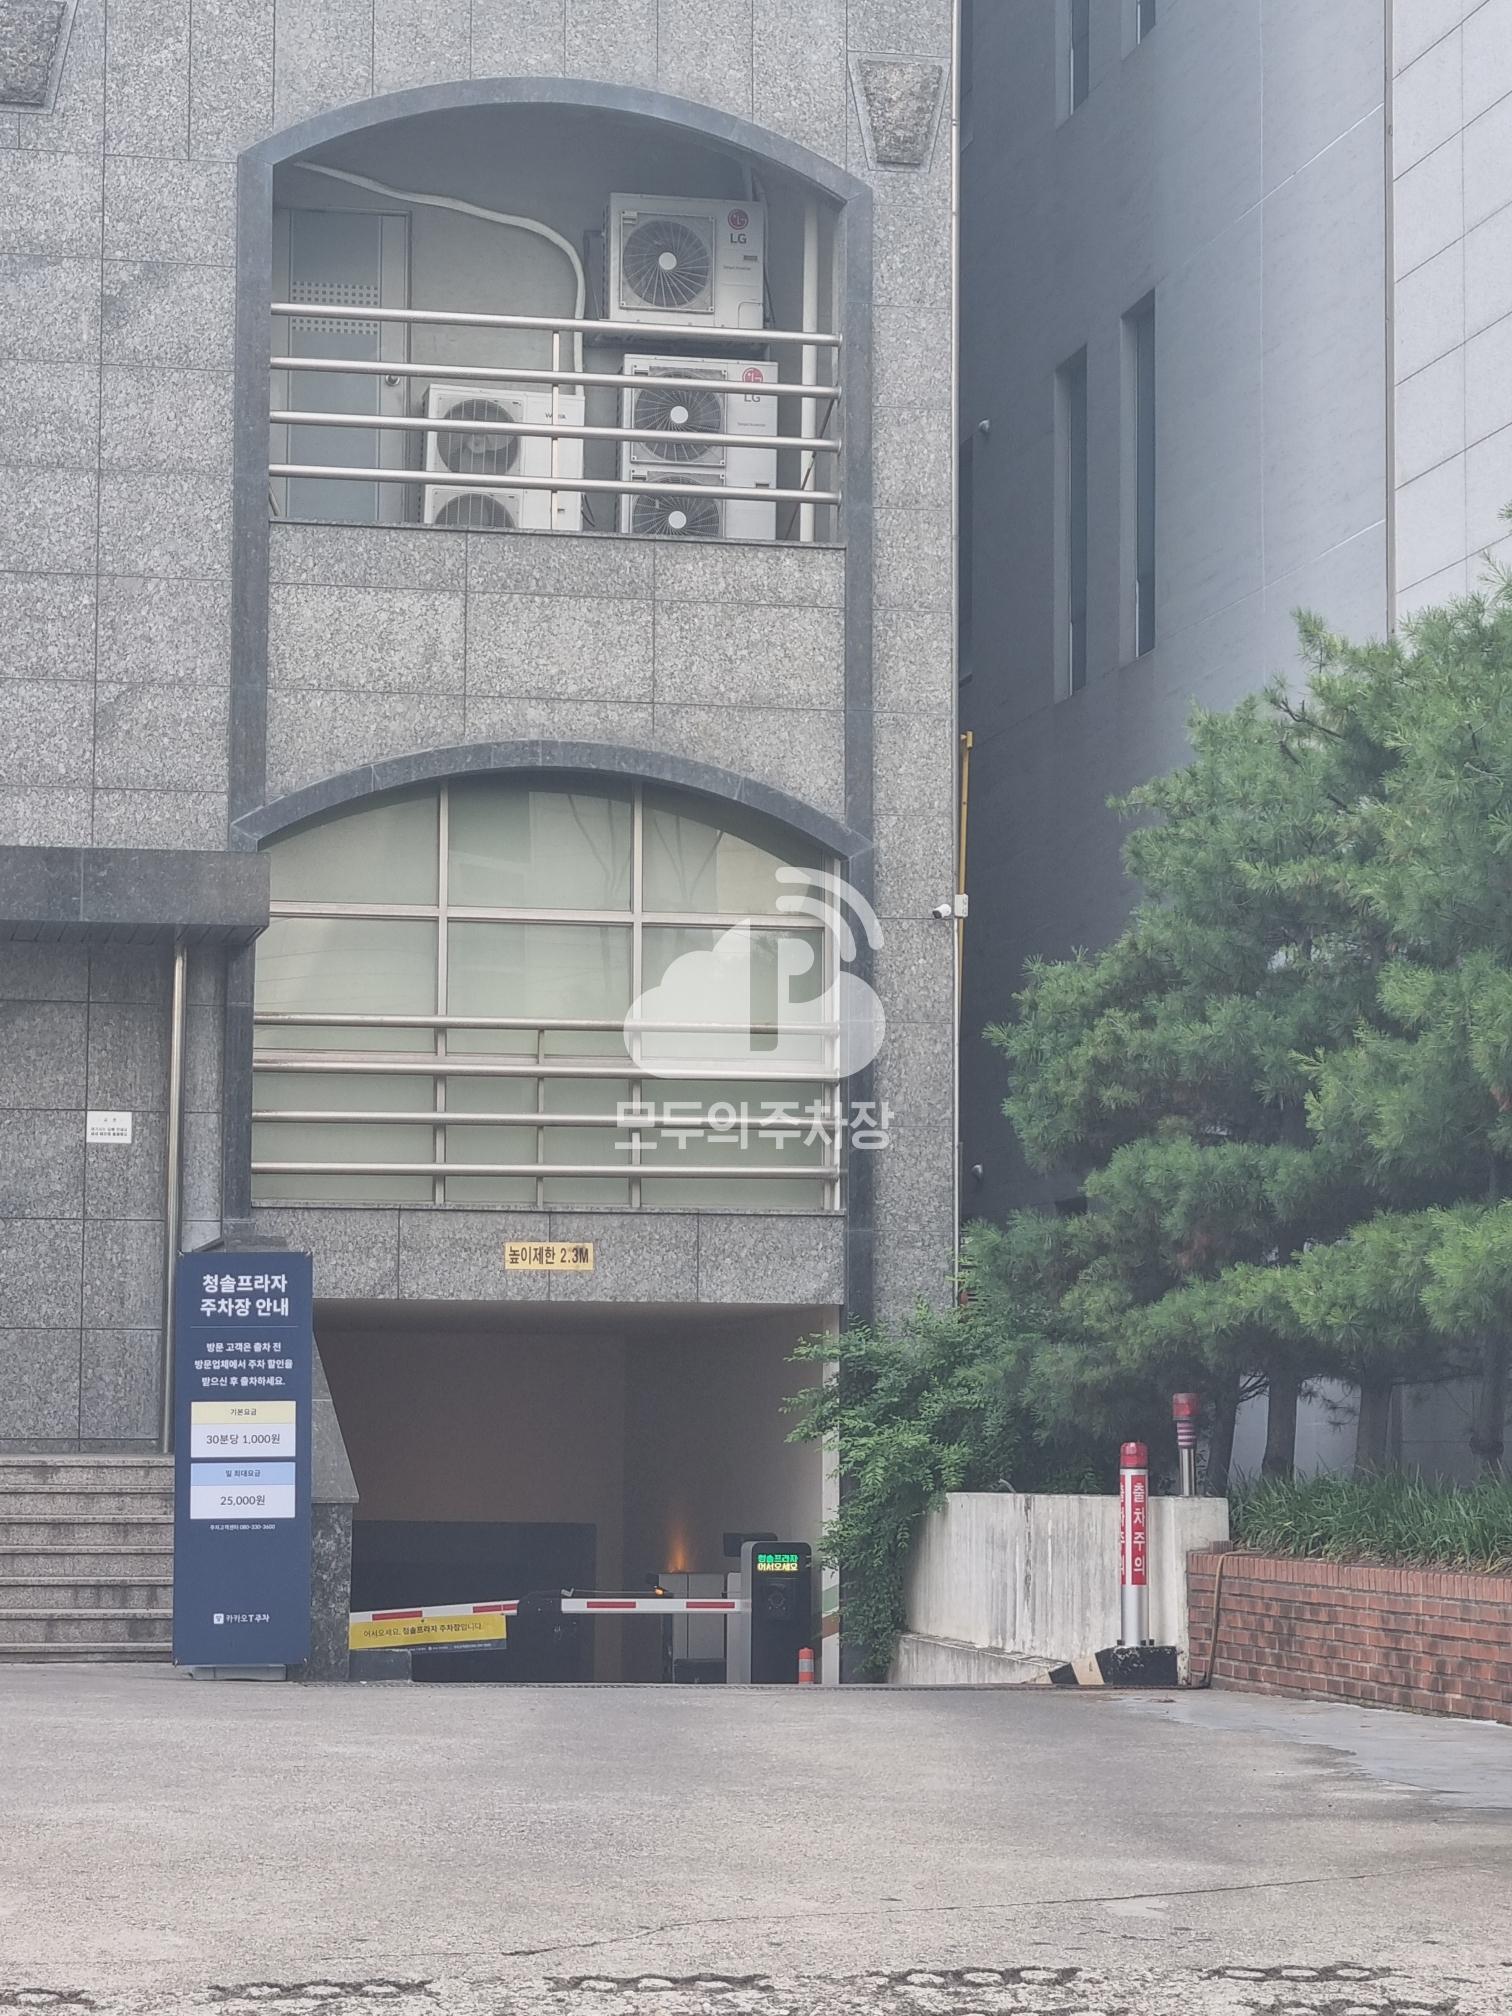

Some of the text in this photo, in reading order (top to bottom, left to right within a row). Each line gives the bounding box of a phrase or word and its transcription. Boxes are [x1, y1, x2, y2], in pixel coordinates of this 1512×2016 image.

[730, 233, 747, 244] LG
[744, 393, 761, 402] LG
[509, 1246, 589, 1265] 높이제한 2.3M
[202, 1274, 288, 1293] 청솔프라자
[200, 1298, 289, 1317] 주차장 안내
[206, 1342, 281, 1352] 방문 고객은 출차 전
[194, 1360, 246, 1370] 방문업체에서
[248, 1359, 265, 1370] 주차
[201, 1377, 228, 1387] 받으신
[229, 1377, 239, 1386] 후
[230, 1408, 257, 1416] 기본요금
[206, 1433, 280, 1445] 30분당 1,000원
[220, 1495, 265, 1506] 25,000원
[1133, 1482, 1145, 1576] 출차주의
